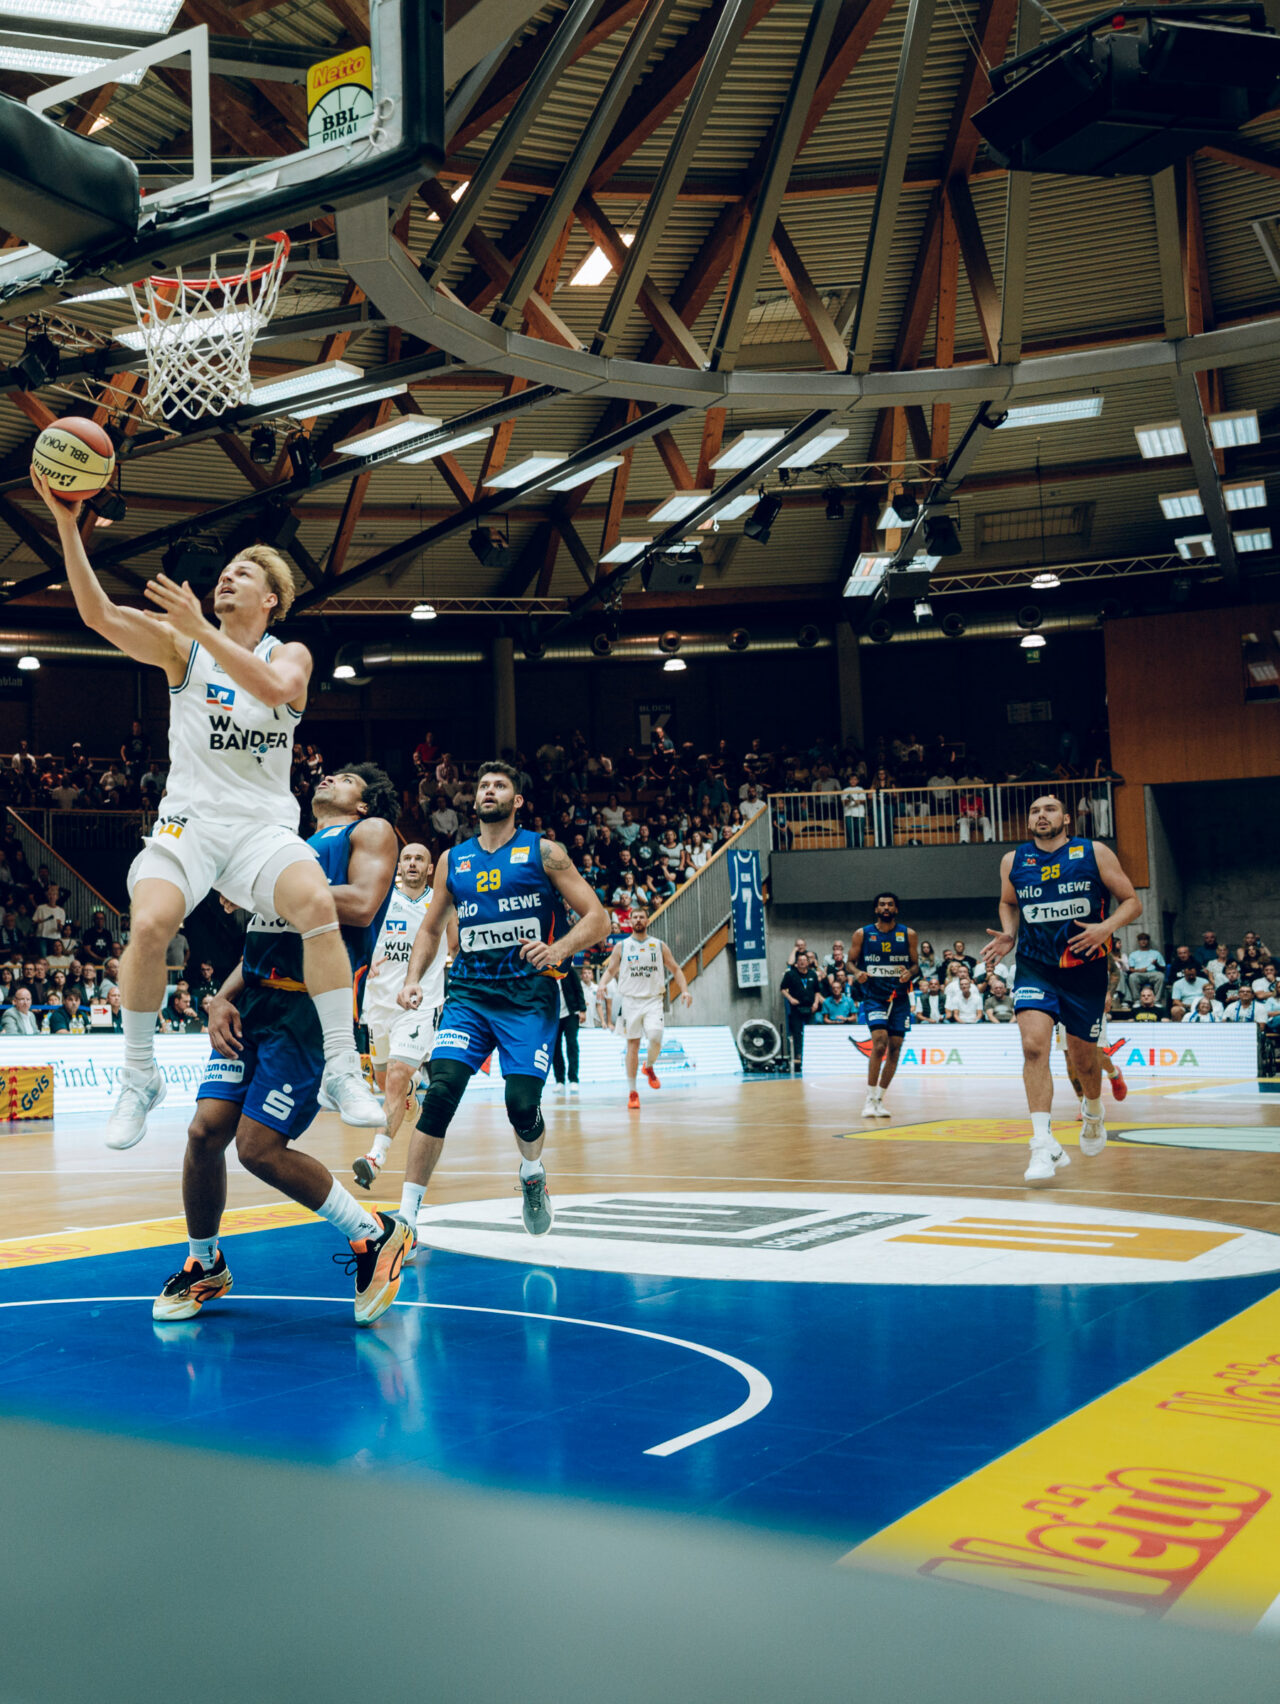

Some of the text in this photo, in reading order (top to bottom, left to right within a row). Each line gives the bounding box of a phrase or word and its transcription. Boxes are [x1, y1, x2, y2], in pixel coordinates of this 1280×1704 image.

[313, 56, 365, 88] Netto
[323, 107, 360, 132] BBL
[70, 446, 90, 464] BBL
[209, 715, 288, 748] WDER
[476, 869, 501, 892] 29
[1041, 864, 1061, 881] 25
[1017, 881, 1092, 899] wilo REWE
[498, 893, 542, 912] REWE
[741, 887, 752, 930] 7
[1041, 904, 1084, 918] Thalia
[478, 926, 537, 945] Thalia
[881, 942, 892, 952] 12
[901, 1048, 963, 1065] AIDA
[1125, 1048, 1199, 1066] AIDA
[21, 1074, 50, 1111] Geis
[917, 1467, 1273, 1622] Netto
